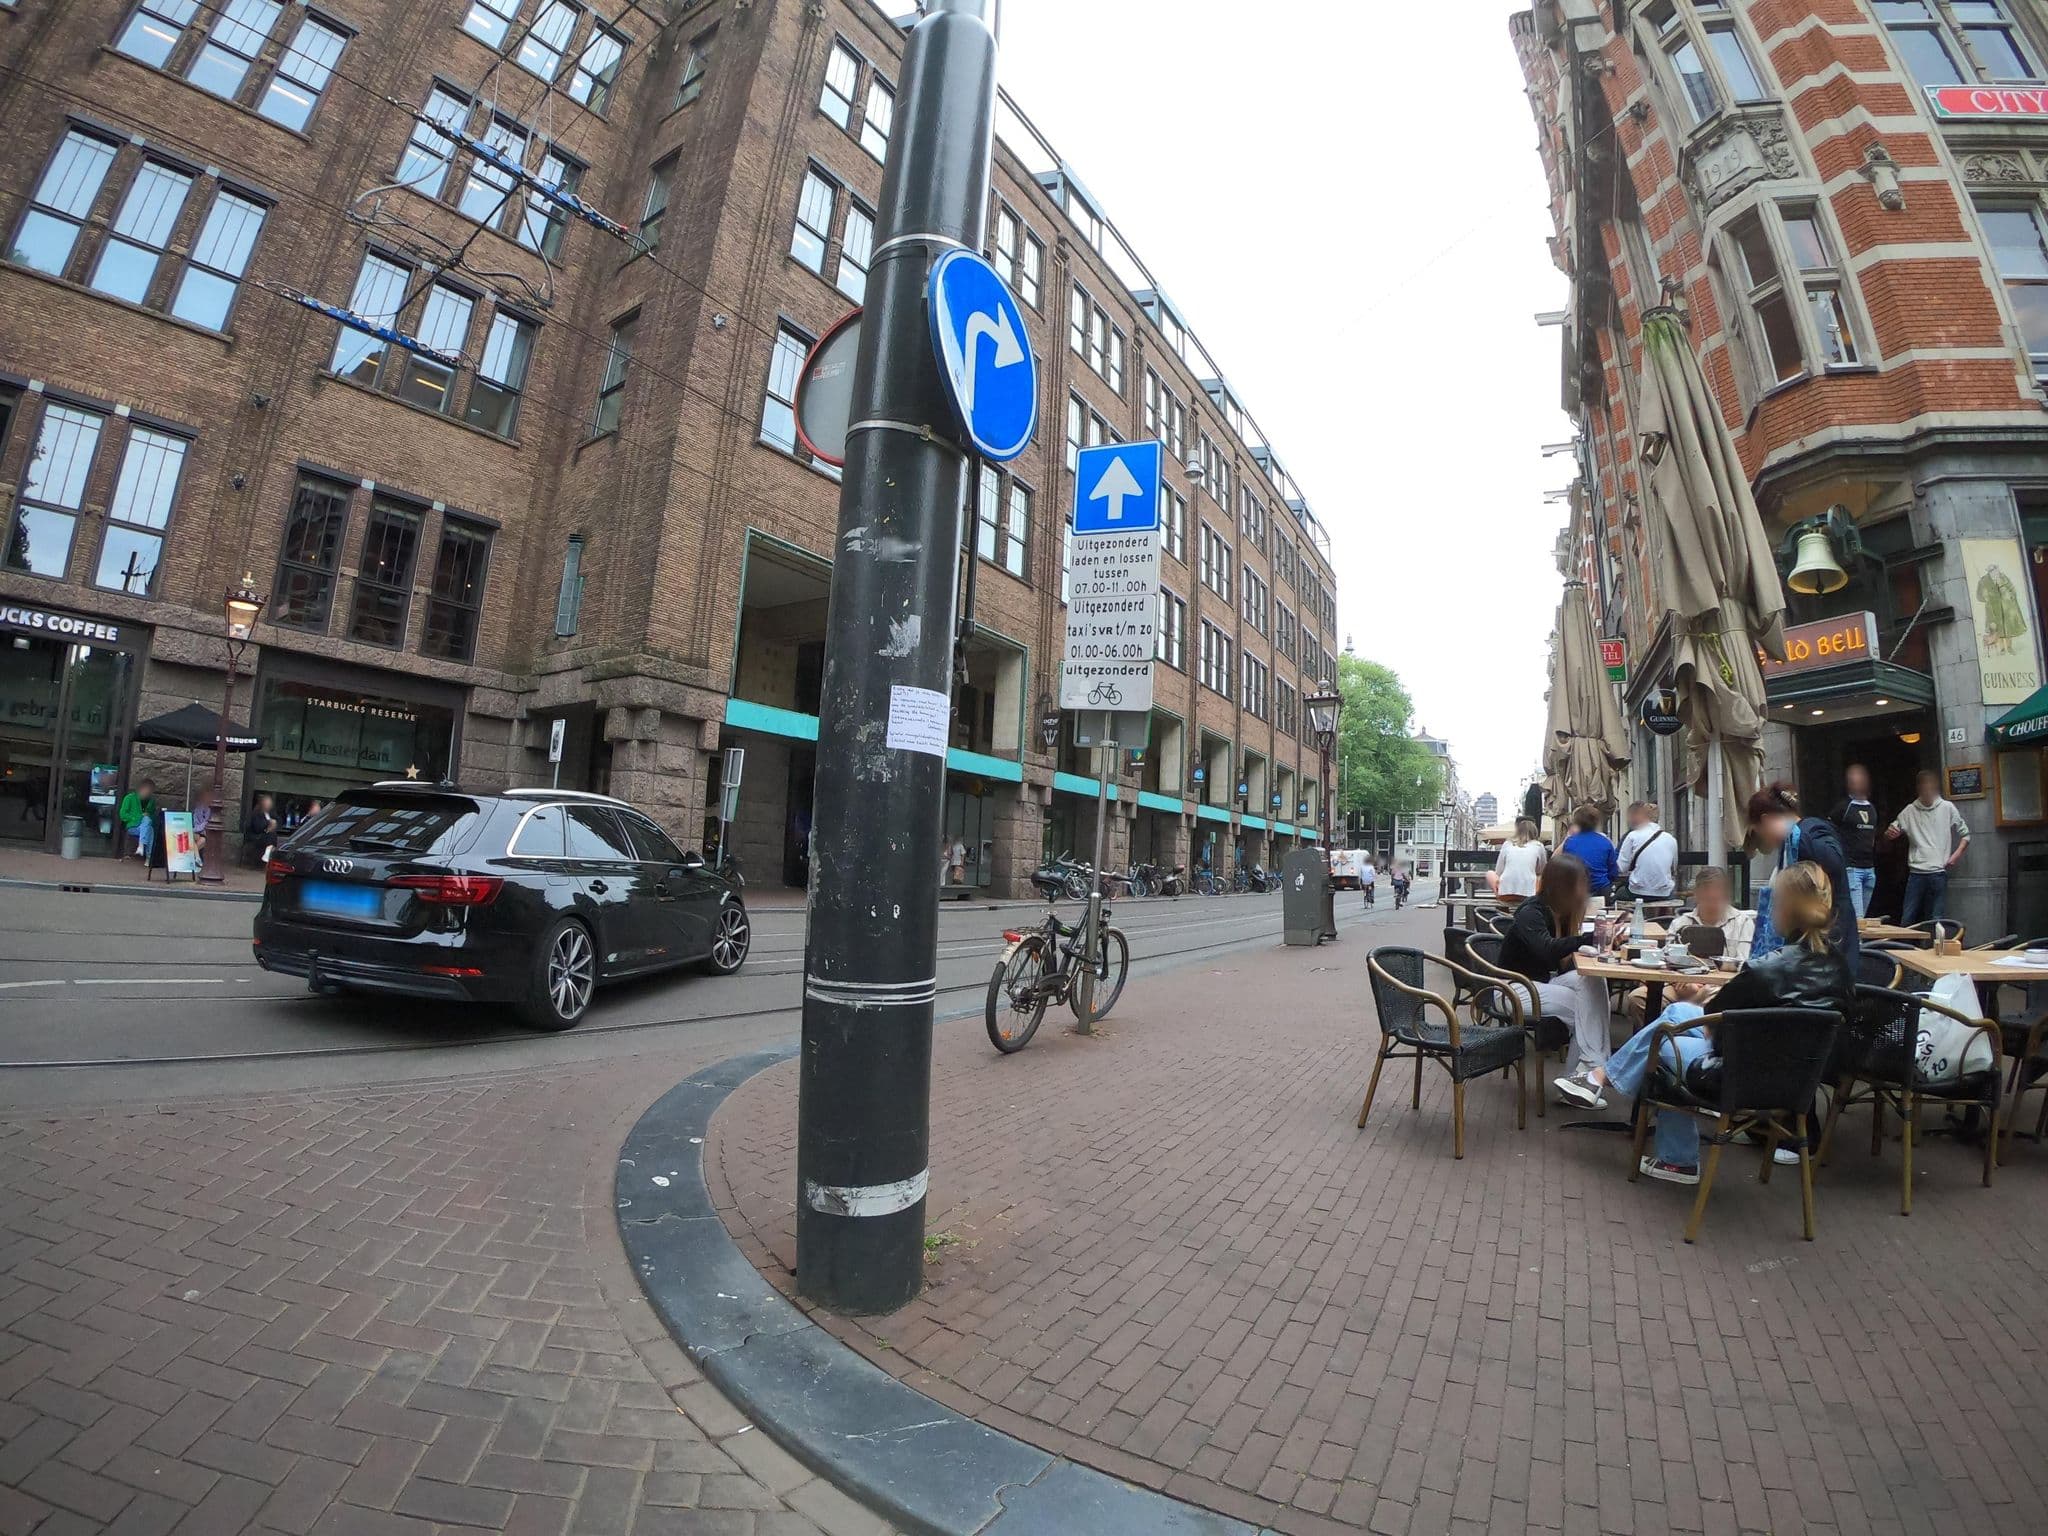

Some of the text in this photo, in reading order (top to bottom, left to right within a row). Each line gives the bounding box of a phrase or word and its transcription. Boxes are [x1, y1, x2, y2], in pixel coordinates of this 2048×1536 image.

[1970, 91, 2047, 112] CITY
[1077, 536, 1148, 553] Uitgezonderd
[1071, 553, 1153, 566] laden en lossen
[1094, 568, 1129, 579] tussen
[1074, 597, 1145, 617] Uitgezonderd
[47, 616, 118, 641] COFFEE
[1067, 620, 1152, 637] taxi's VR t/m zo
[1817, 627, 1865, 655] BELL
[1071, 643, 1143, 658] 01.00-06.00h
[1066, 665, 1149, 678] uitgezonderd
[1984, 671, 2036, 689] GUINNESS
[307, 698, 417, 722] STARBUCKS RESERVE
[1950, 730, 1964, 741] 46
